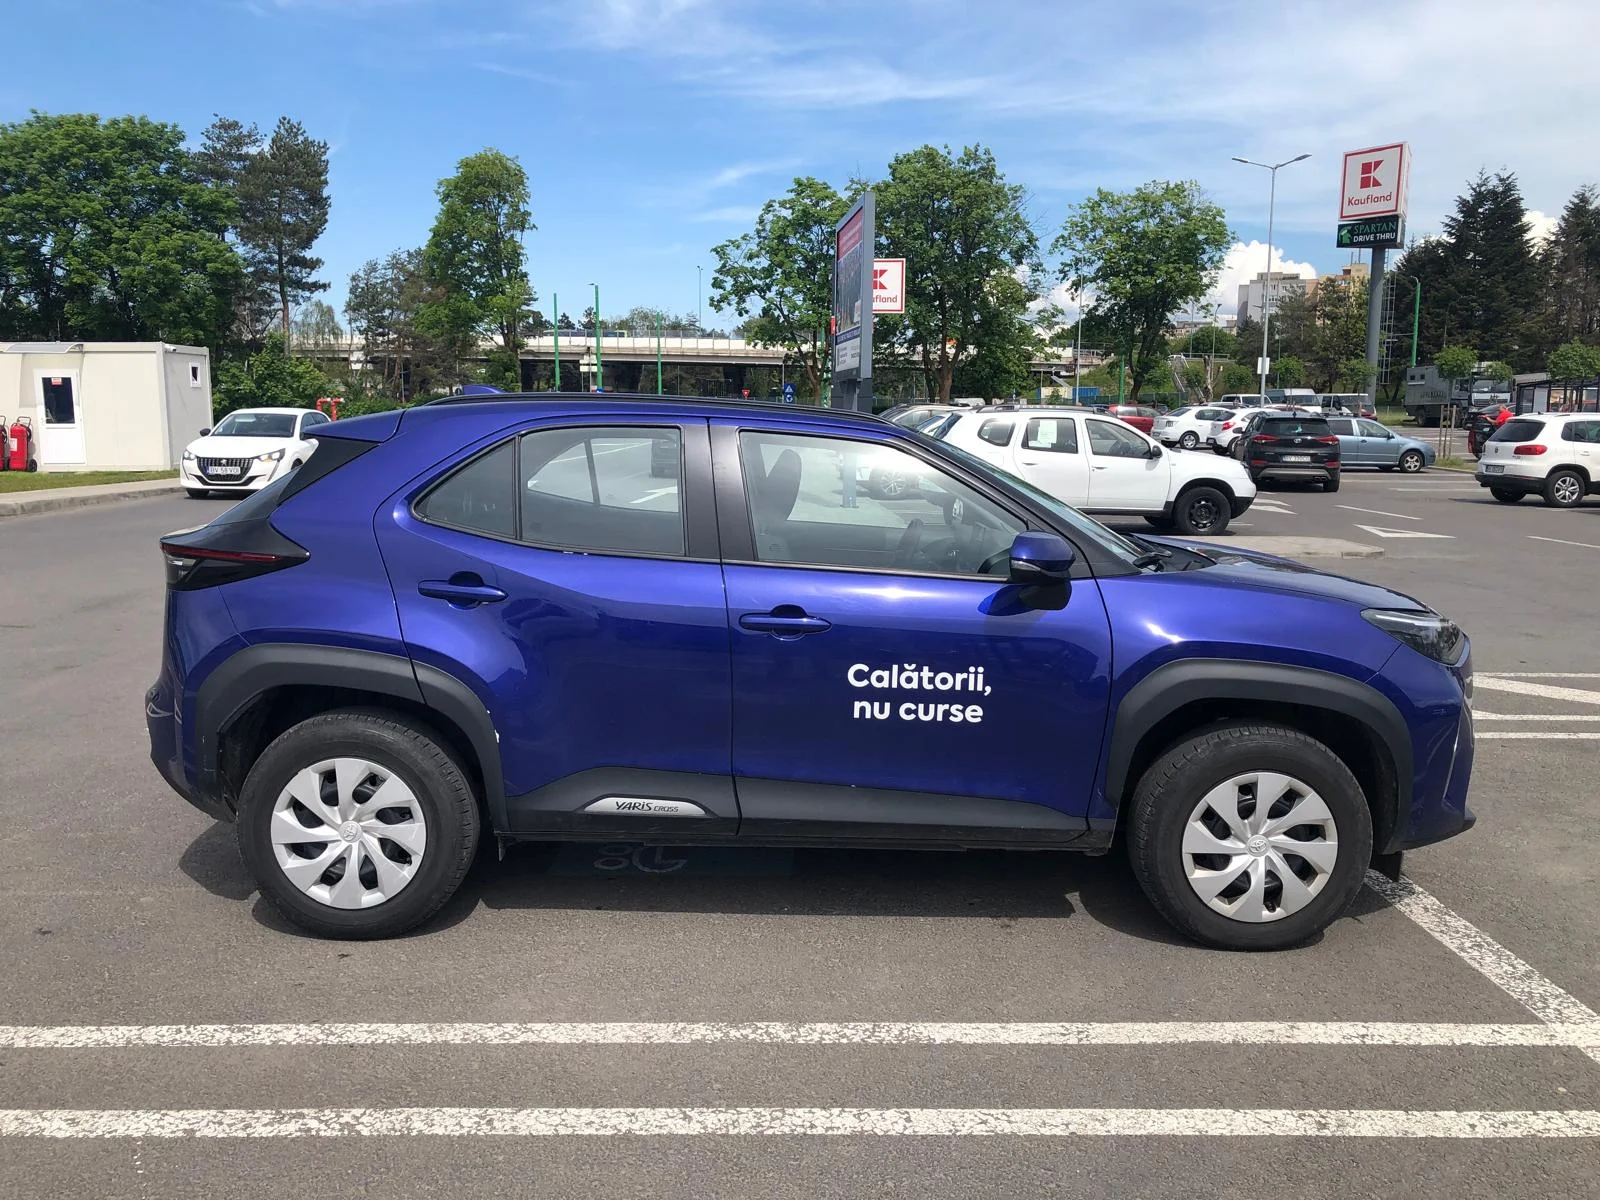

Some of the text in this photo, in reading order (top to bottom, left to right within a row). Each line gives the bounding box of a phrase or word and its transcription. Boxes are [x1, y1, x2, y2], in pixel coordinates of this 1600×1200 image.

[1347, 192, 1392, 206] Kaufland
[1353, 222, 1397, 234] SPARTAN
[1353, 232, 1396, 243] DRIVE THRU
[873, 295, 898, 303] fland
[847, 663, 992, 696] Calătorii,
[853, 700, 984, 723] nu curse
